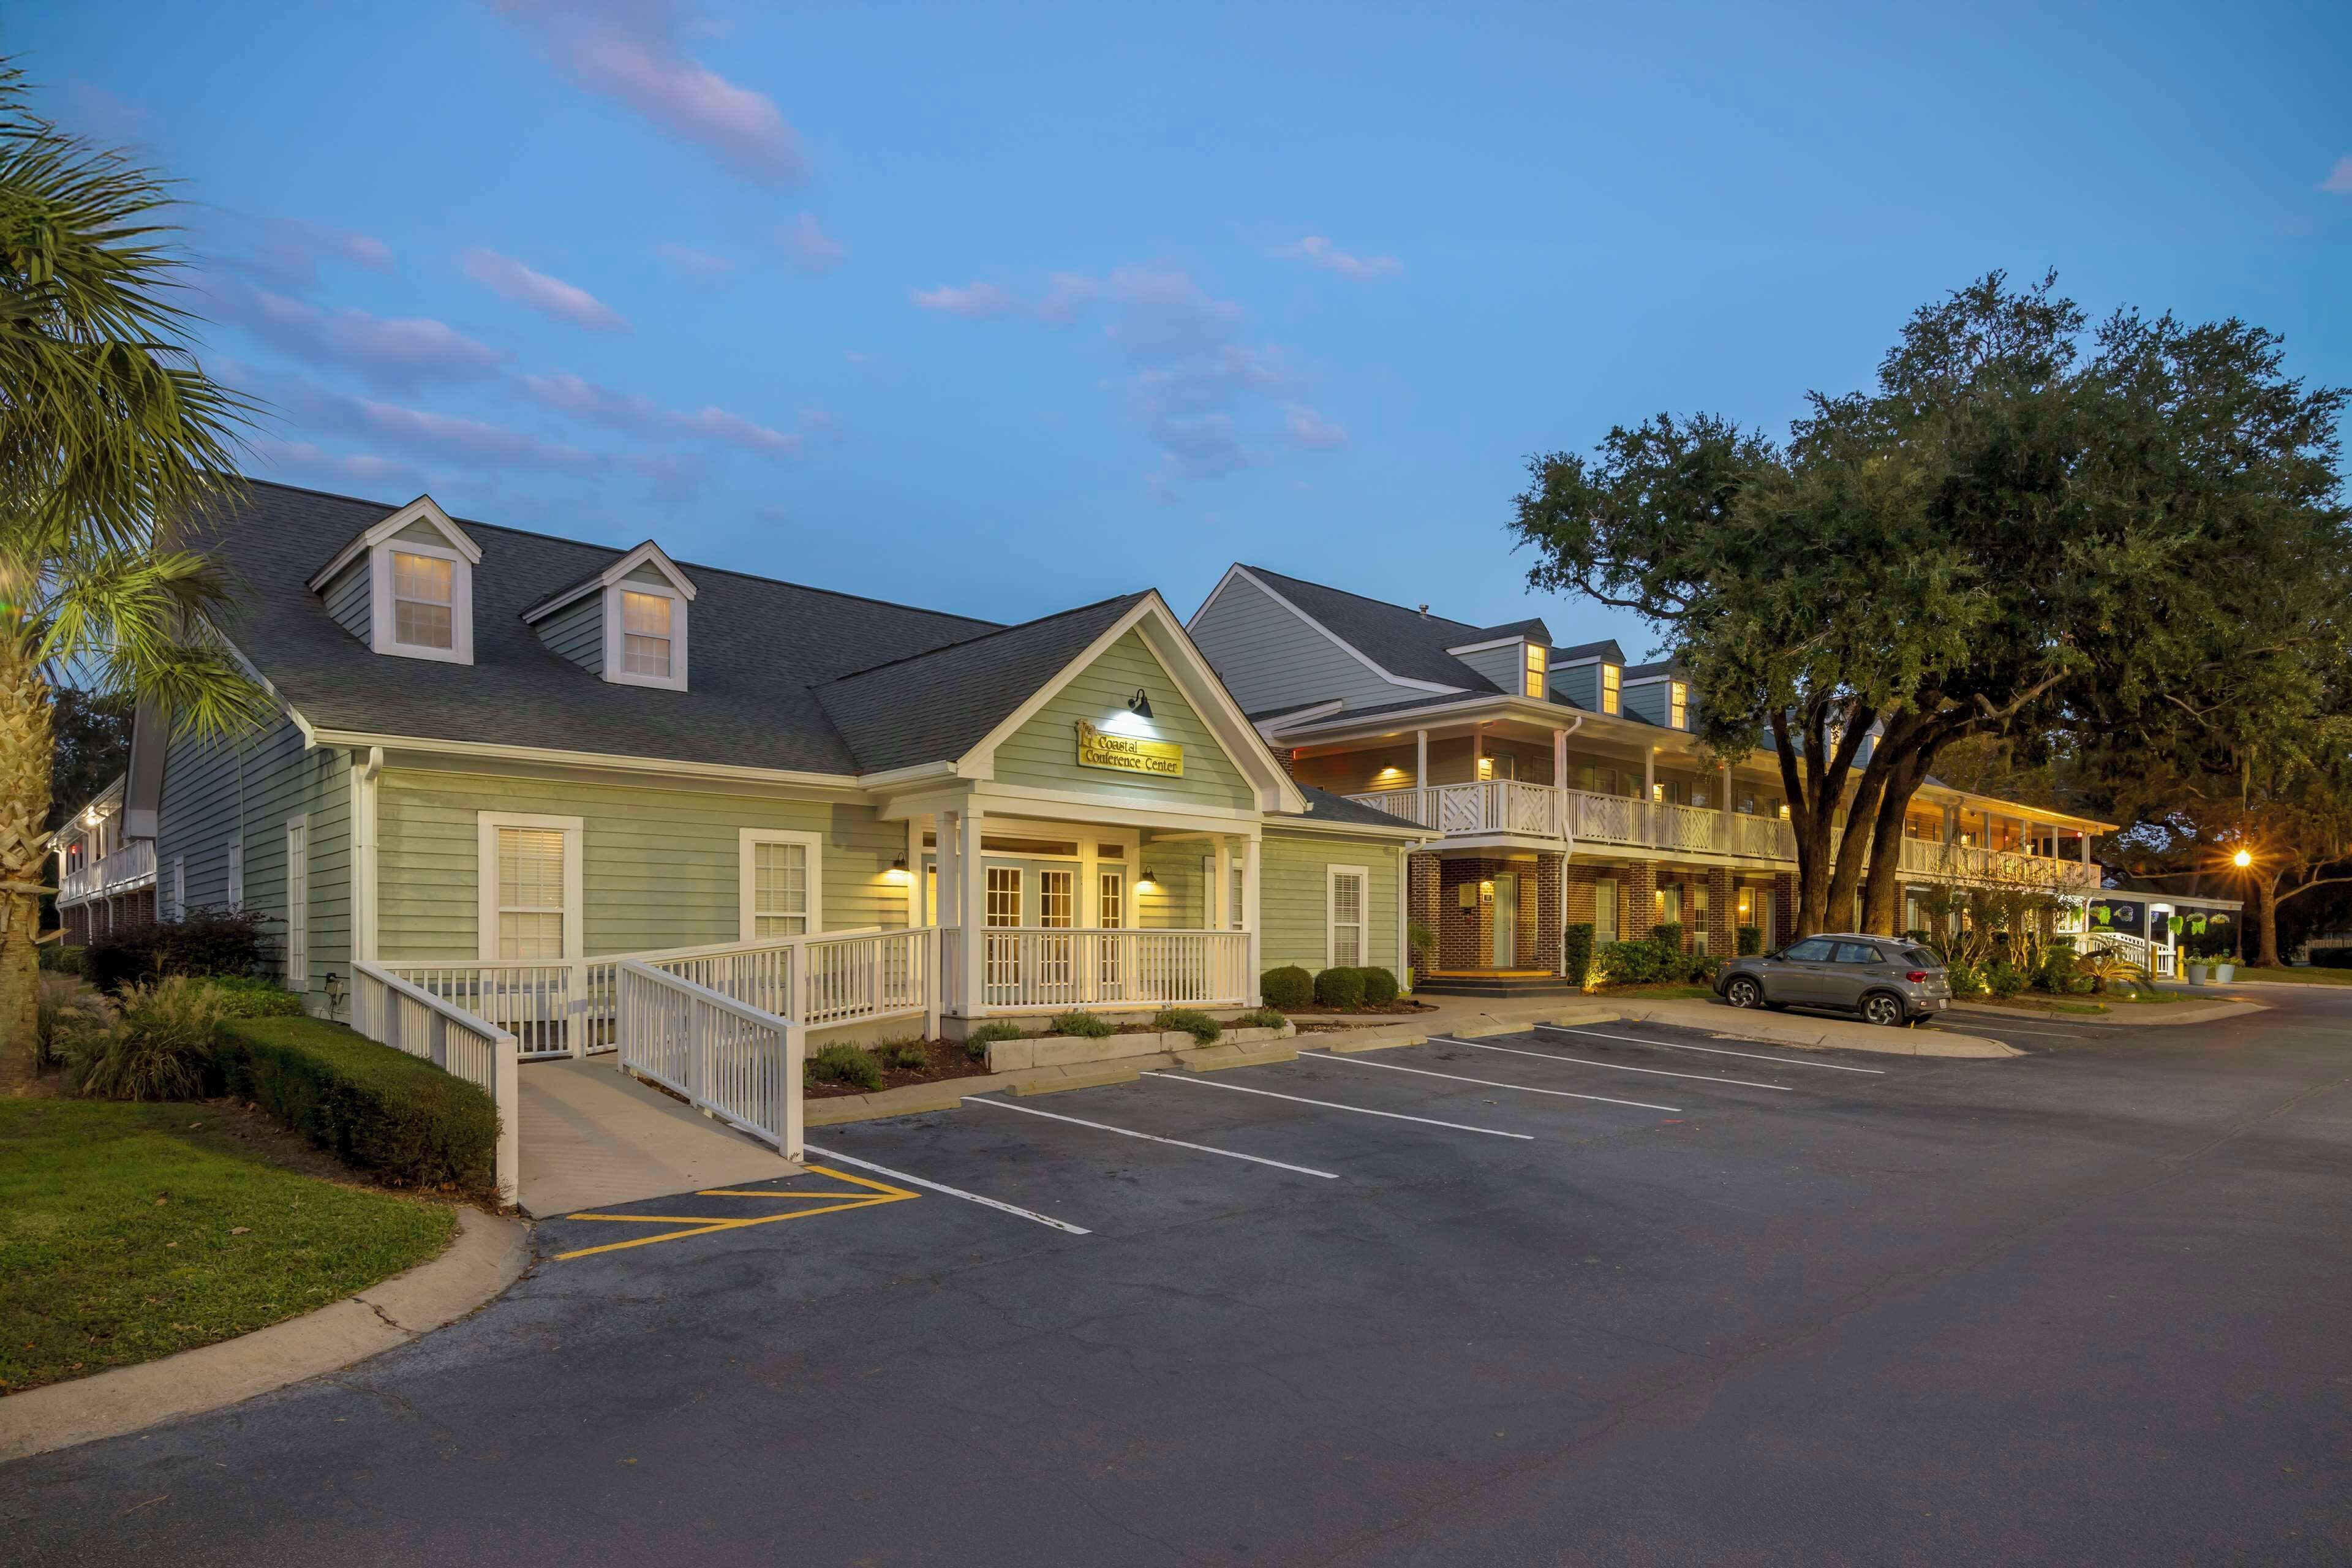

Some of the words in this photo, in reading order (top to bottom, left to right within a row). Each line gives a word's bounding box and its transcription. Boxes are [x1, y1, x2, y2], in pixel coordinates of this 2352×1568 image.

[1099, 736, 1137, 753] Coastal
[1086, 749, 1140, 769] Conference
[1145, 758, 1177, 773] Center
